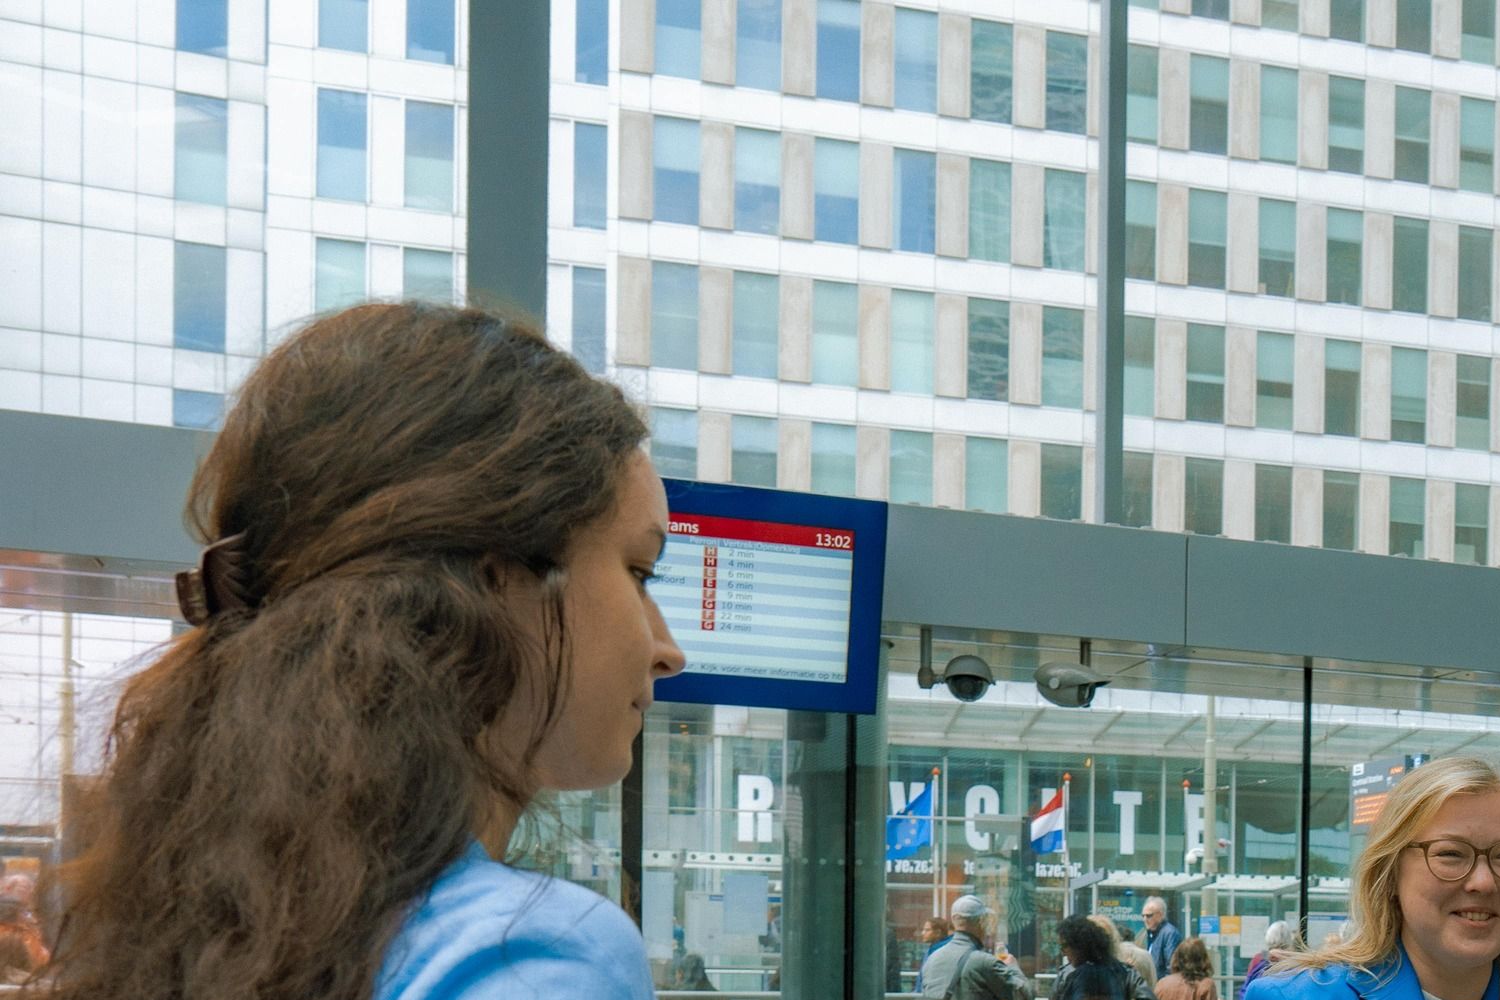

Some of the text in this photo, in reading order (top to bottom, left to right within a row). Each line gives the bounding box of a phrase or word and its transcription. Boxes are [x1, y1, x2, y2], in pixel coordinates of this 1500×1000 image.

[667, 521, 851, 548] rams 13:02
[738, 549, 754, 558] min
[737, 560, 754, 569] min
[736, 570, 754, 579] min
[736, 581, 753, 590] min
[736, 592, 752, 600] min
[722, 601, 733, 609] 10
[735, 602, 752, 611] min
[734, 612, 752, 622] min
[720, 622, 732, 630] 24
[734, 623, 751, 632] min
